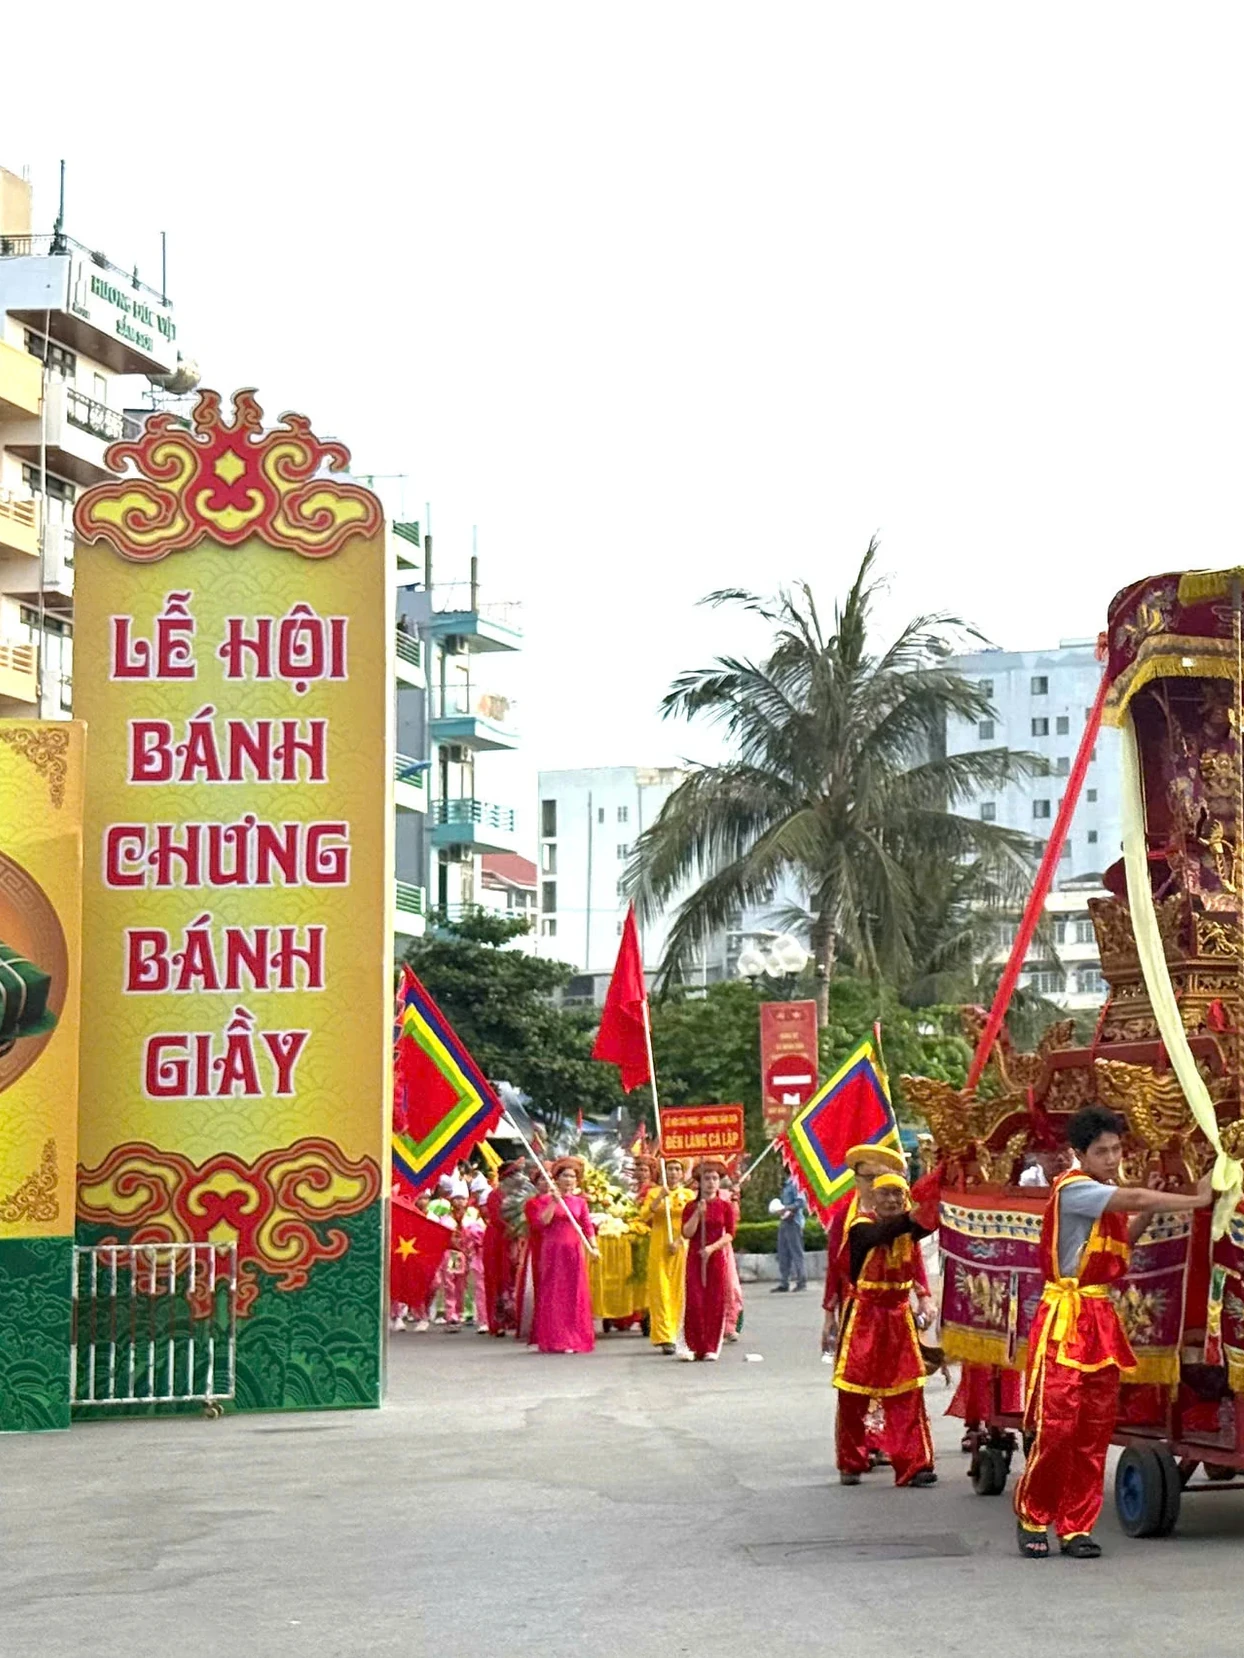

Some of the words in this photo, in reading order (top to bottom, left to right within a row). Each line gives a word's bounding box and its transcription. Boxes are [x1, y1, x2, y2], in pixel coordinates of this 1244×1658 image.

[112, 591, 195, 679] LỄ
[219, 604, 348, 692] HỘI
[130, 706, 327, 783] BÁNH
[105, 814, 349, 886] CHƯNG
[126, 914, 324, 991] BÁNH
[145, 1007, 308, 1096] GIẦY
